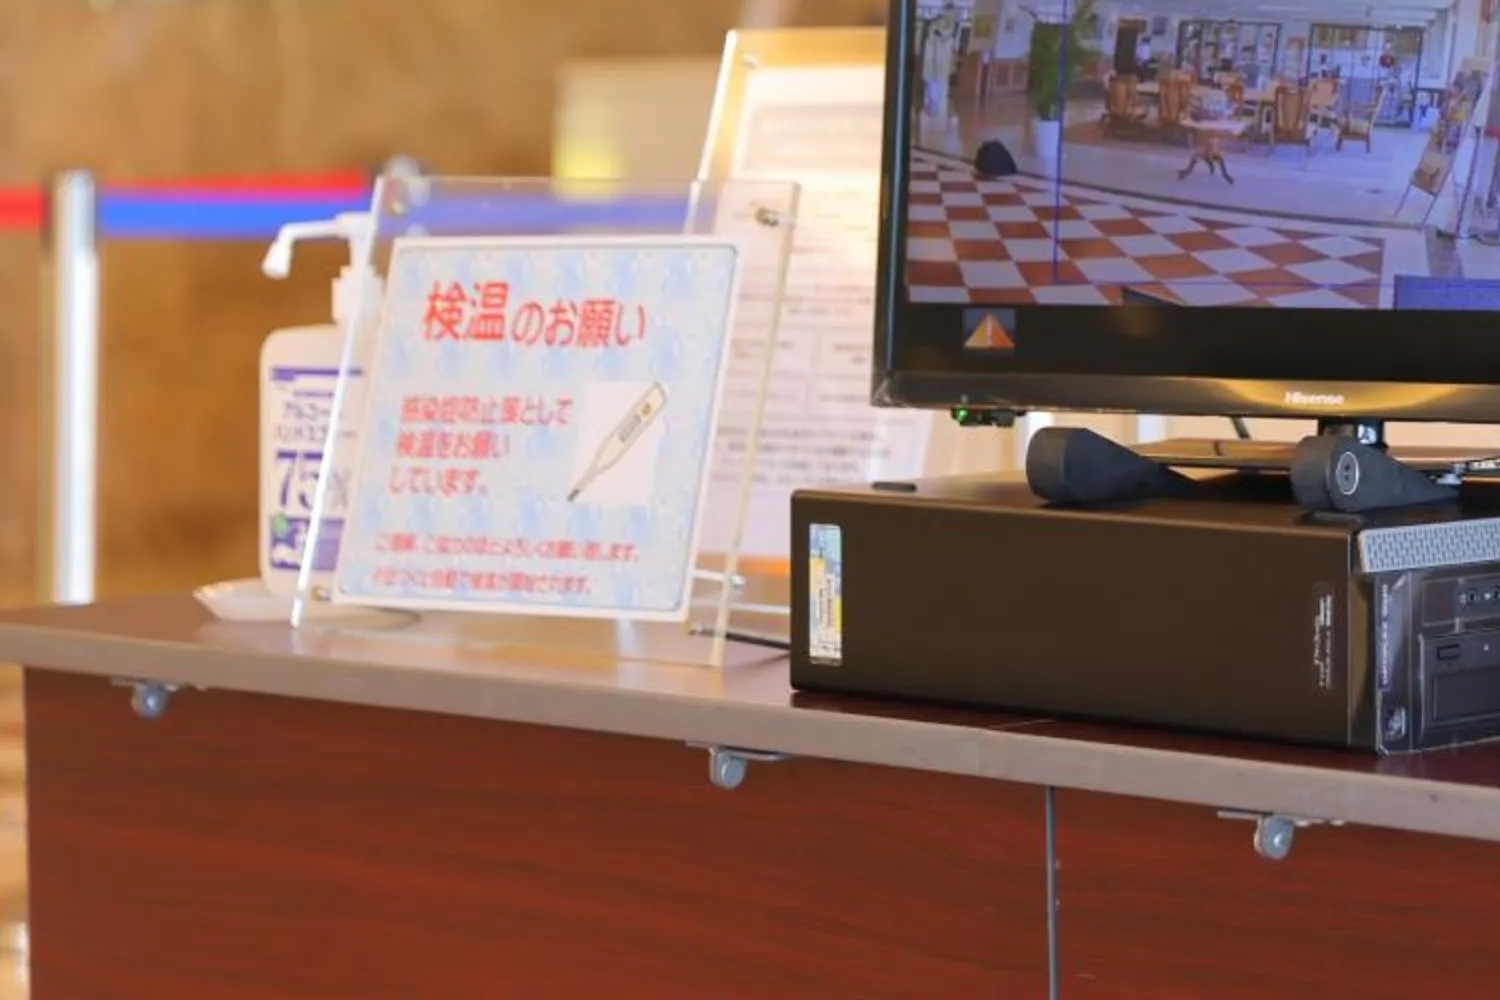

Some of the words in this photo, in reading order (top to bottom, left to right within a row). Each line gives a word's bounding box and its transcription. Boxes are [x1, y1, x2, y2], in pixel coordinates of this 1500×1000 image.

[424, 281, 646, 347] 検温のお願い
